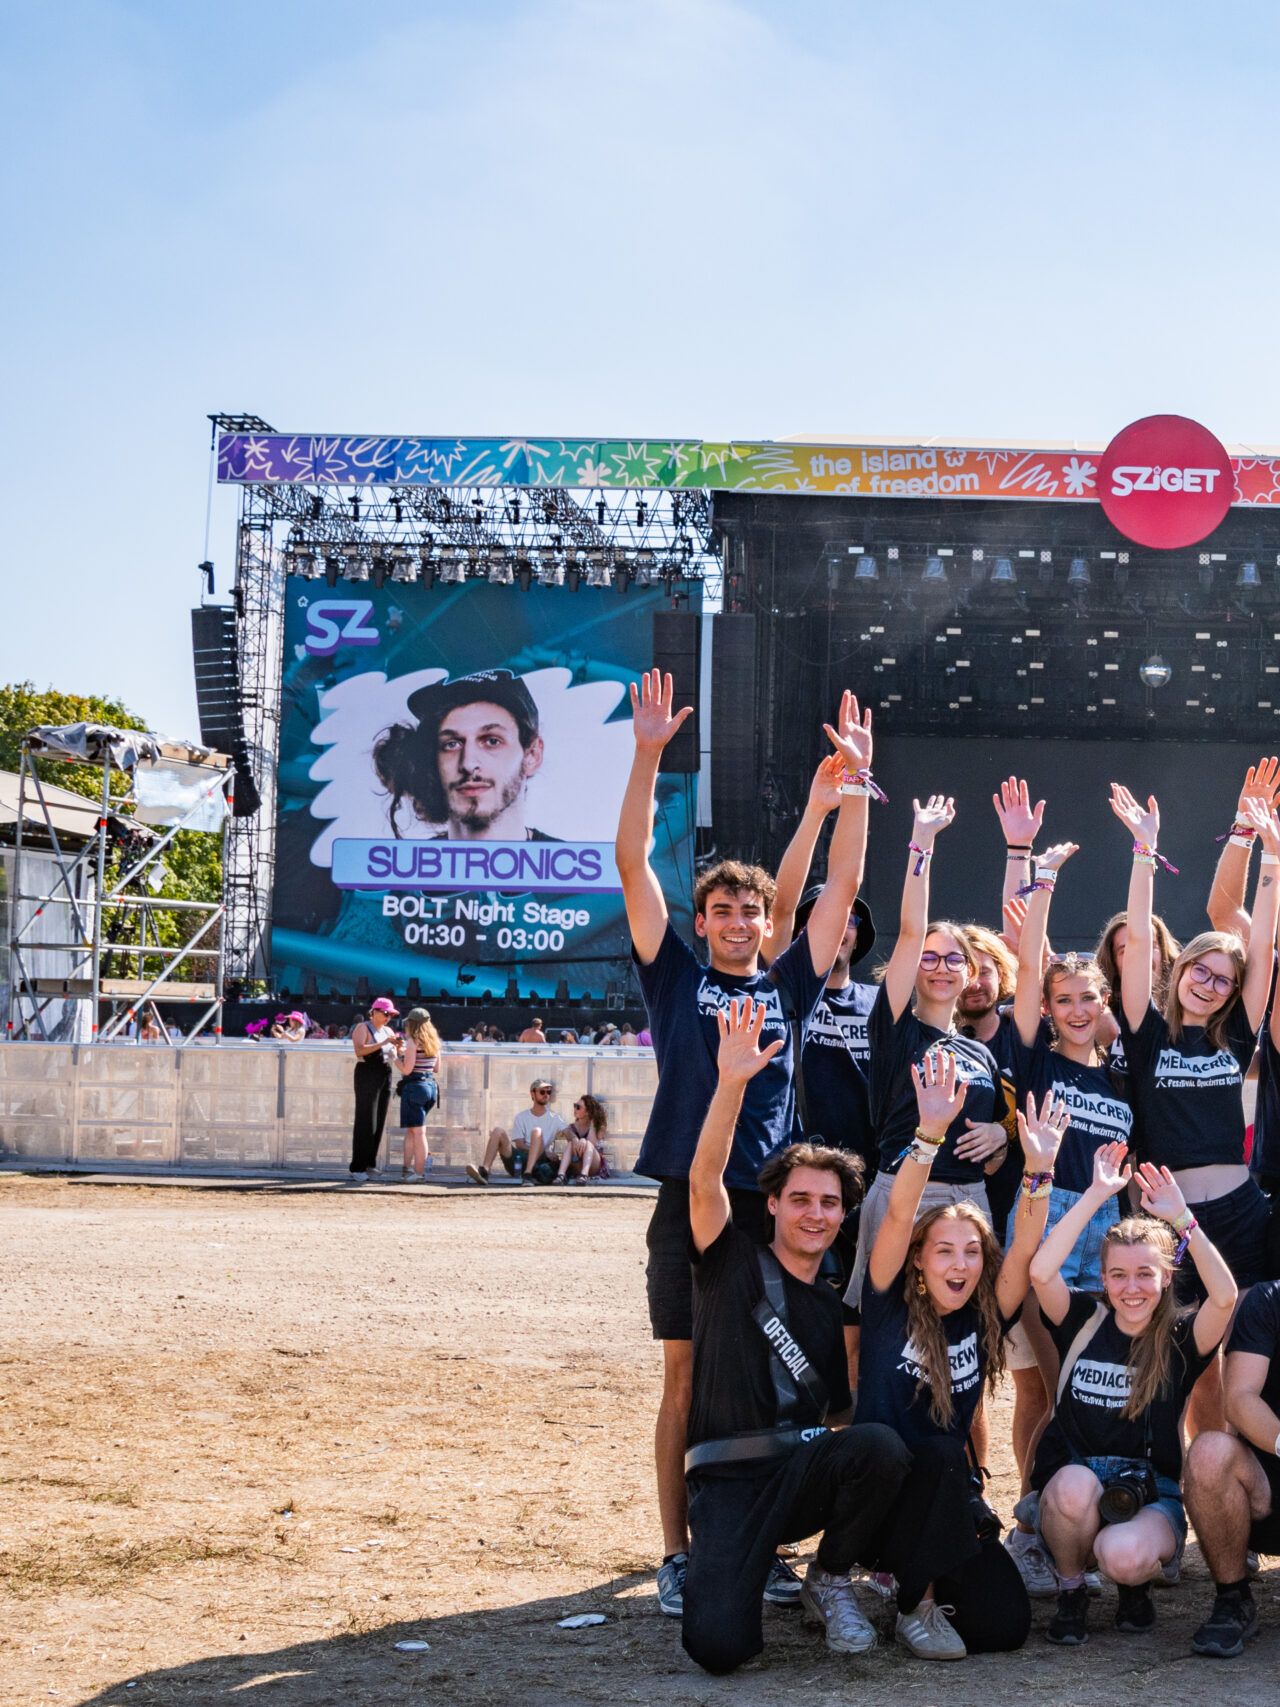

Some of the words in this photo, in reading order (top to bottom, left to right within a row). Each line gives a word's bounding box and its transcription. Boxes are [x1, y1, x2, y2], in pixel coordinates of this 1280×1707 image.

[809, 454, 851, 477] the
[861, 450, 937, 474] island
[834, 476, 860, 493] of
[870, 471, 979, 494] freedom
[305, 599, 380, 654] SZ
[367, 845, 603, 881] SUBTRONICS
[382, 895, 449, 920] BOLT
[455, 900, 516, 927] Night
[522, 901, 591, 931] Stage
[404, 923, 466, 947] 01:30
[496, 928, 565, 952] 03:00
[763, 1316, 810, 1381] OFFICIAL
